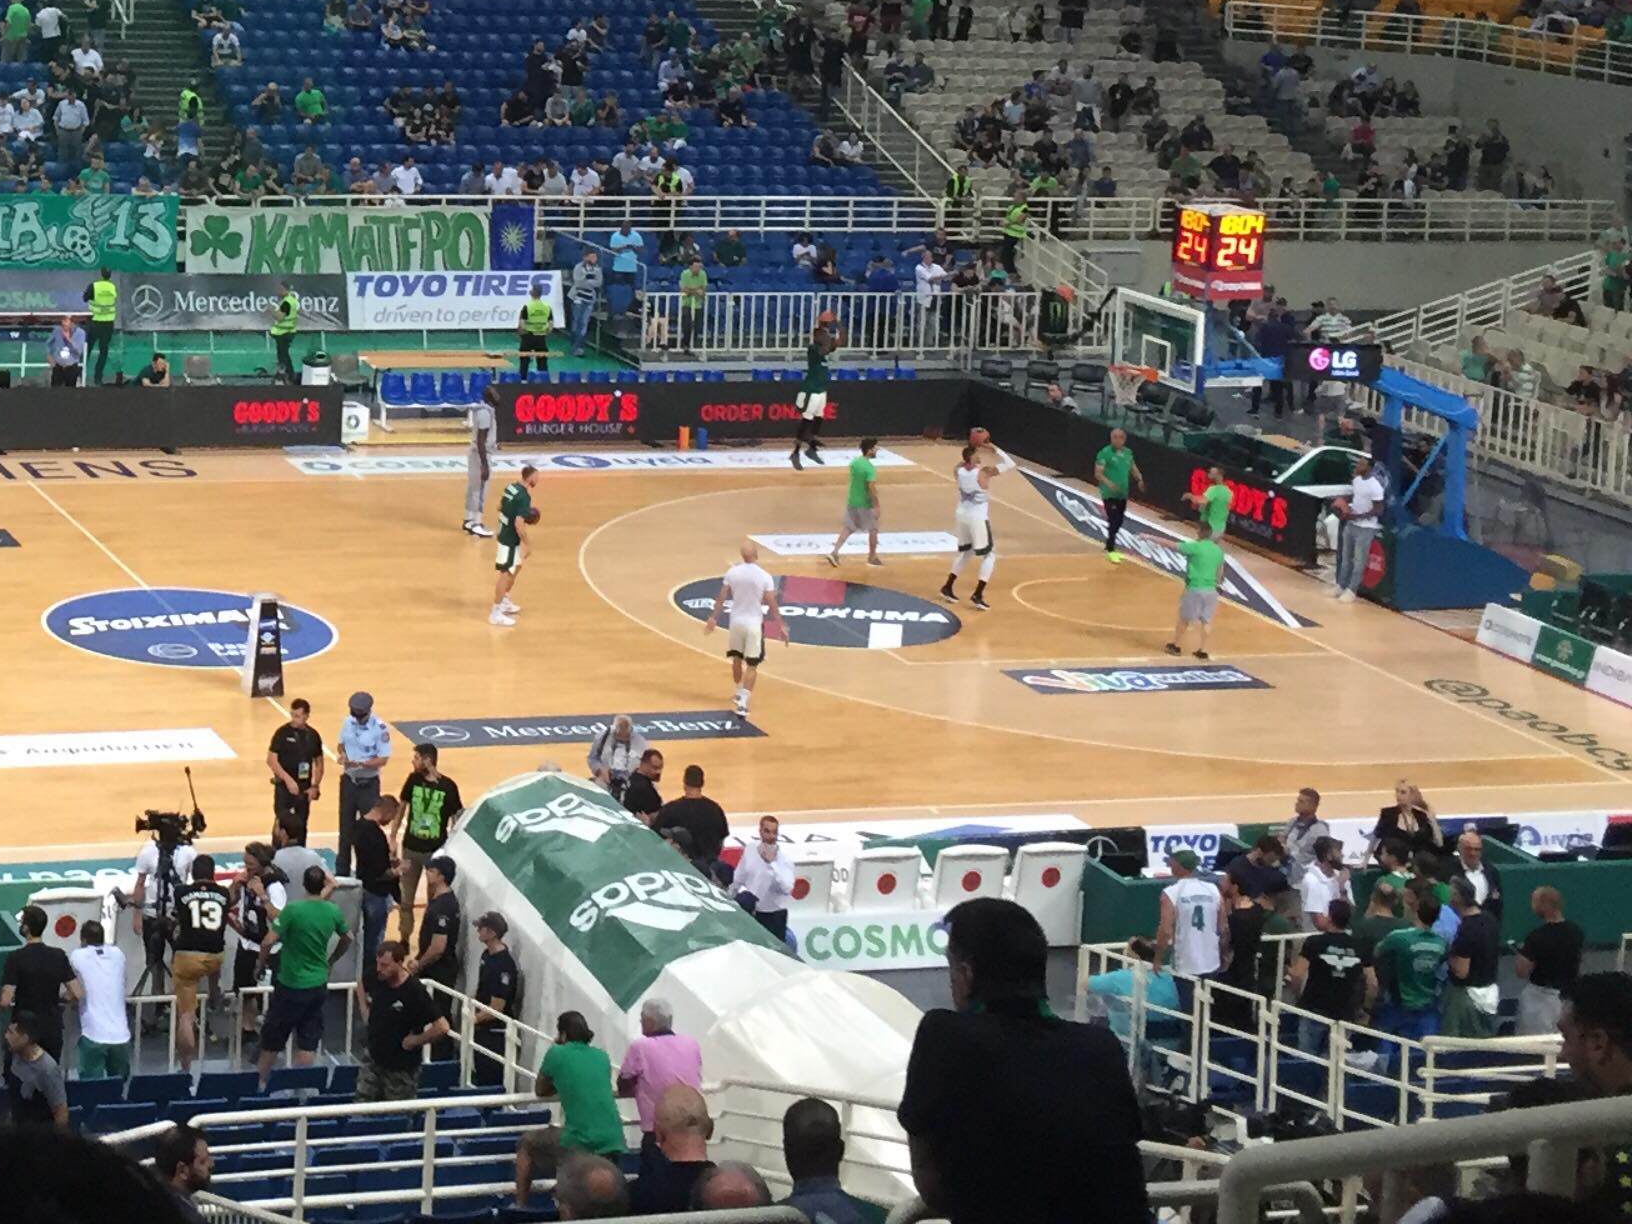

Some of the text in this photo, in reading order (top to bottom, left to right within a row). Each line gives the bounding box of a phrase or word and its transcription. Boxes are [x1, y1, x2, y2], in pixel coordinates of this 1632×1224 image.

[110, 201, 174, 258] 13
[1177, 232, 1208, 263] 24
[1217, 237, 1257, 266] 24
[354, 275, 552, 297] TOYO TIRES
[373, 303, 520, 326] driven to perfor
[1332, 351, 1357, 368] LG
[233, 398, 321, 424] GOODY'S
[515, 390, 639, 423] GOODY'S
[700, 402, 838, 421] ORDER ONE
[525, 423, 574, 436] BURGER
[1150, 834, 1217, 855] TOYO
[188, 900, 223, 930] 13
[805, 923, 951, 961] COSMO
